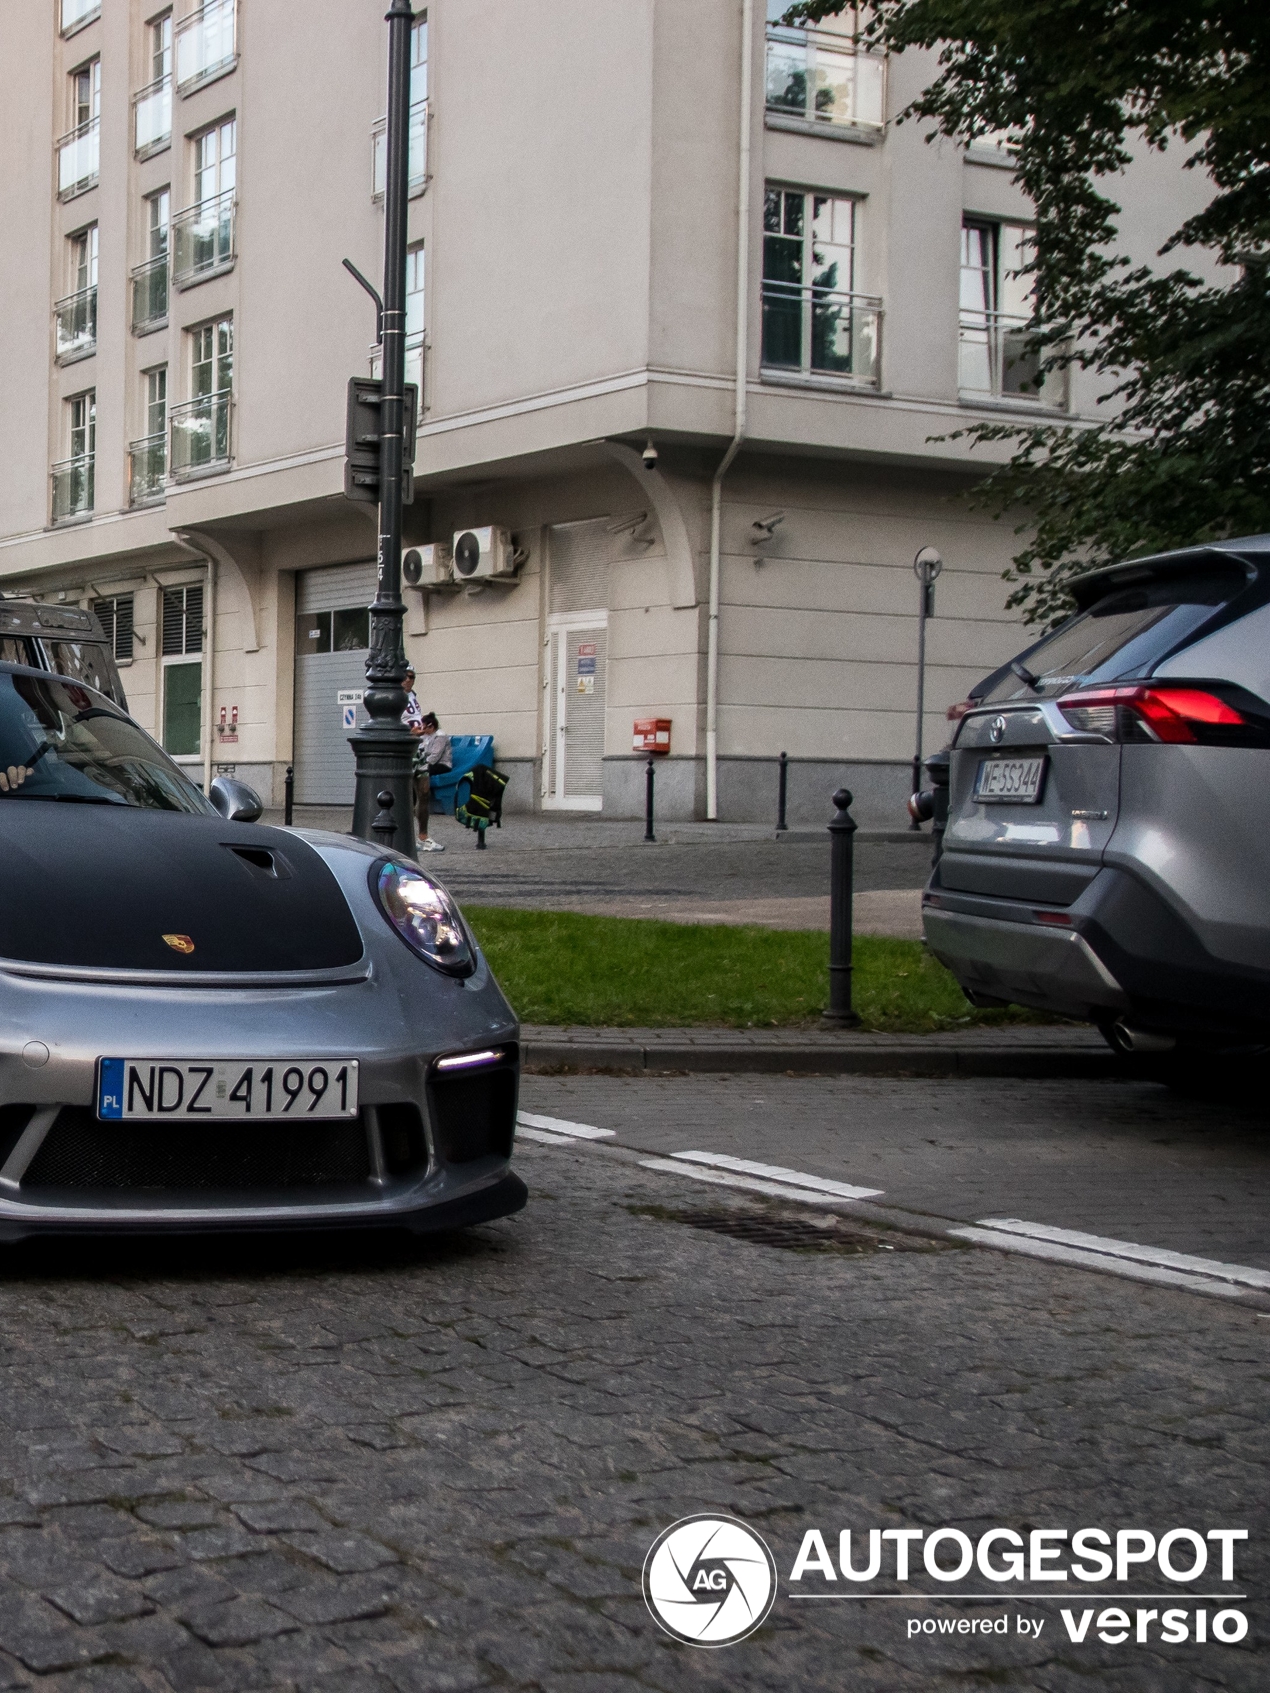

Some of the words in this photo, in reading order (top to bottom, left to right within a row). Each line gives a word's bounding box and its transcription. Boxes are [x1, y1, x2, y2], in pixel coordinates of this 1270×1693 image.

[981, 763, 1000, 793] WE
[103, 1095, 120, 1108] PL
[127, 1065, 214, 1113] NDZ
[228, 1065, 348, 1113] 41991
